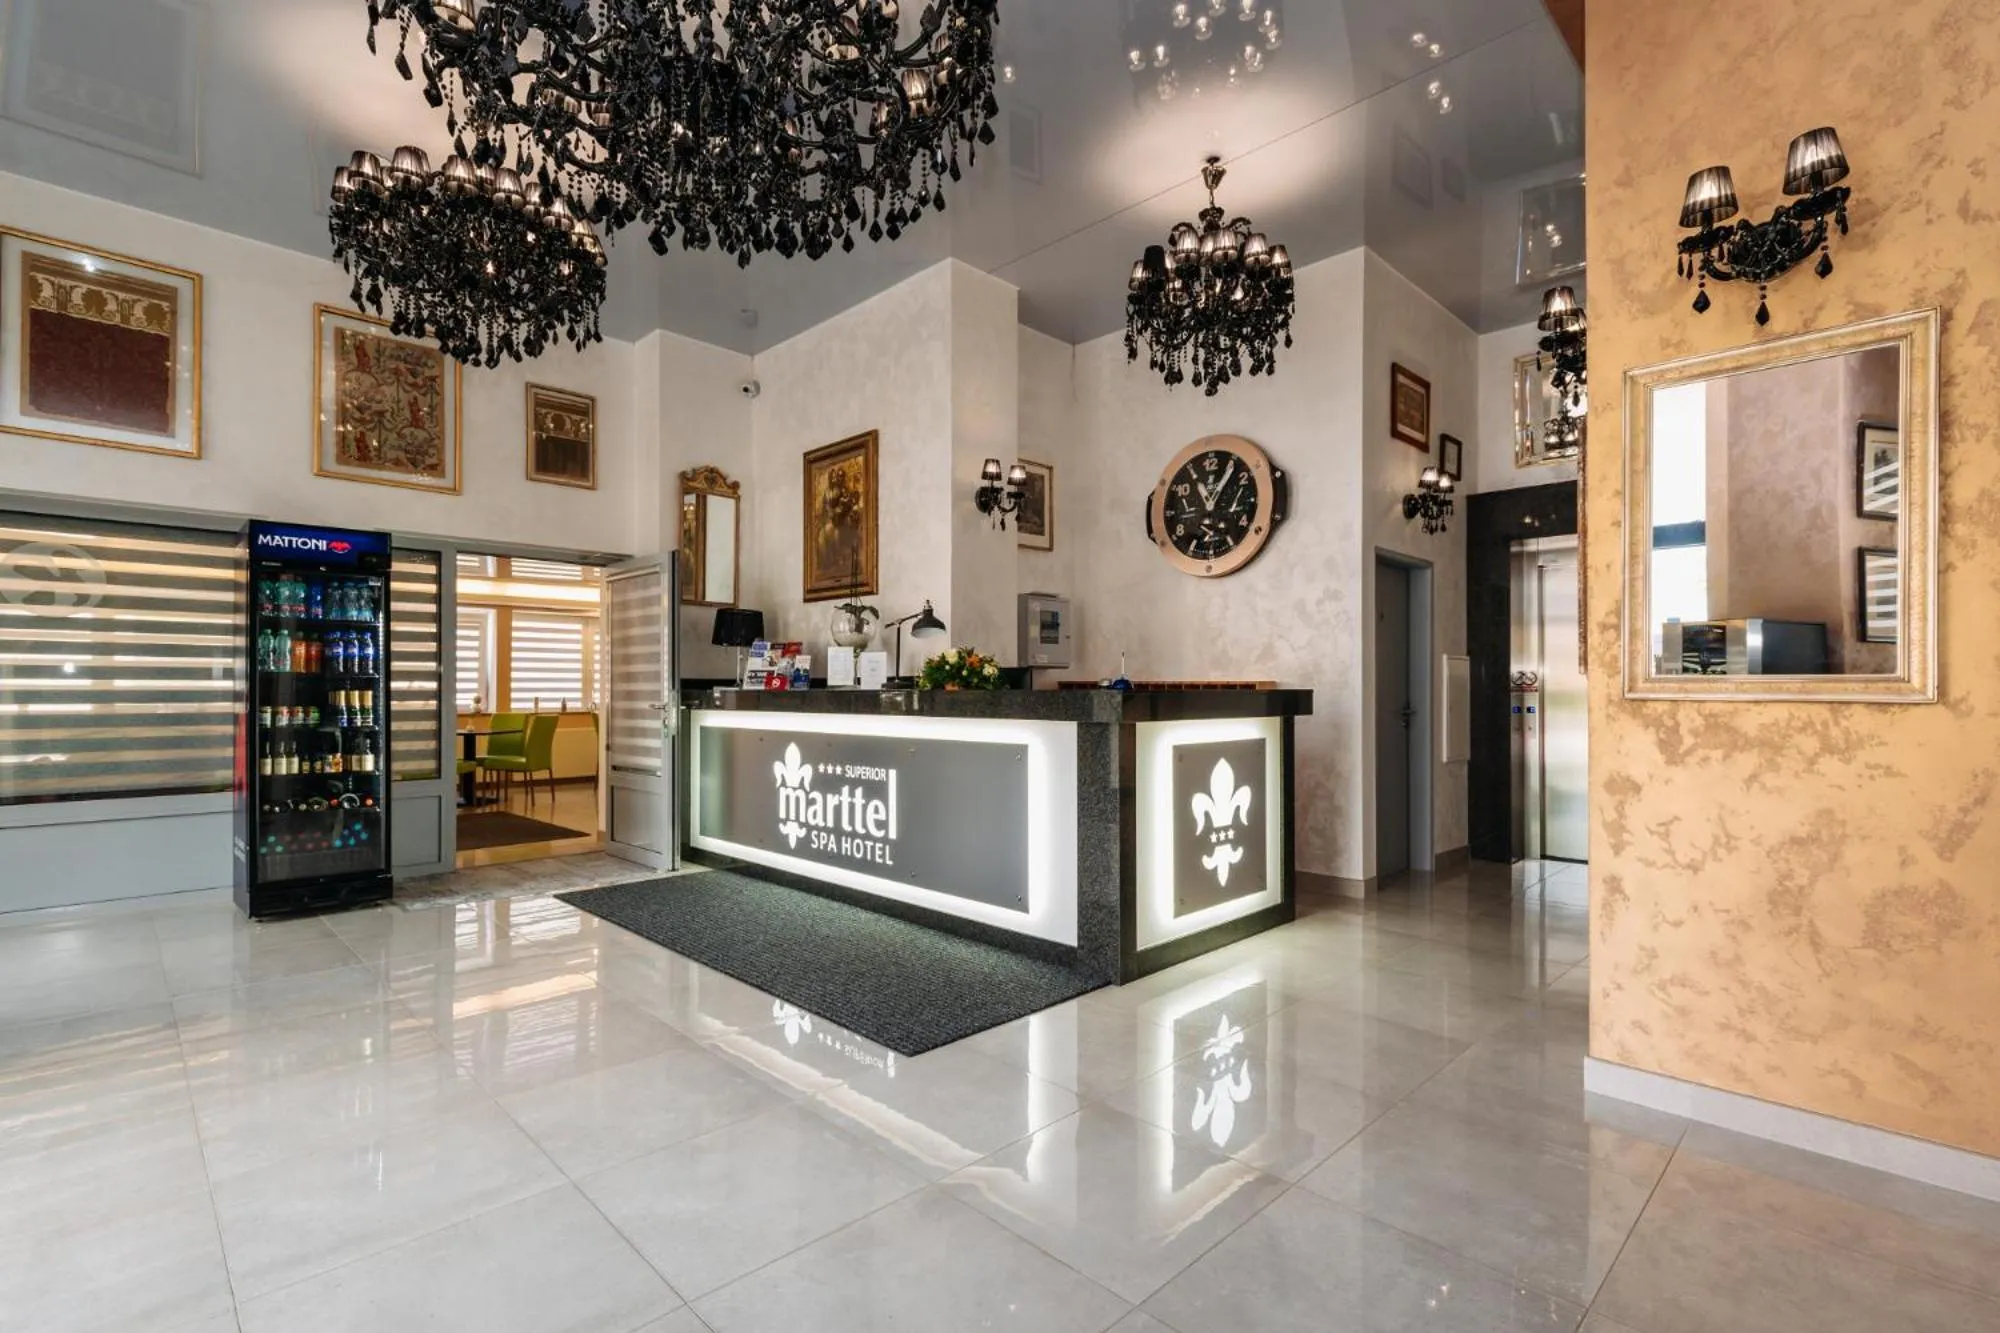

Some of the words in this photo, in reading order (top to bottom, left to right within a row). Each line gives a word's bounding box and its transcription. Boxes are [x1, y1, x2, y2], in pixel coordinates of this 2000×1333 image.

[1203, 458, 1219, 472] 12
[1239, 472, 1249, 485] 2
[1175, 483, 1190, 497] 10
[1239, 514, 1249, 527] 4
[1176, 523, 1185, 536] 8
[258, 534, 327, 551] MATTONI
[845, 764, 887, 781] SUPERIOR
[779, 768, 897, 840] marttel
[811, 830, 837, 853] SPA
[842, 836, 893, 865] HOTEL
